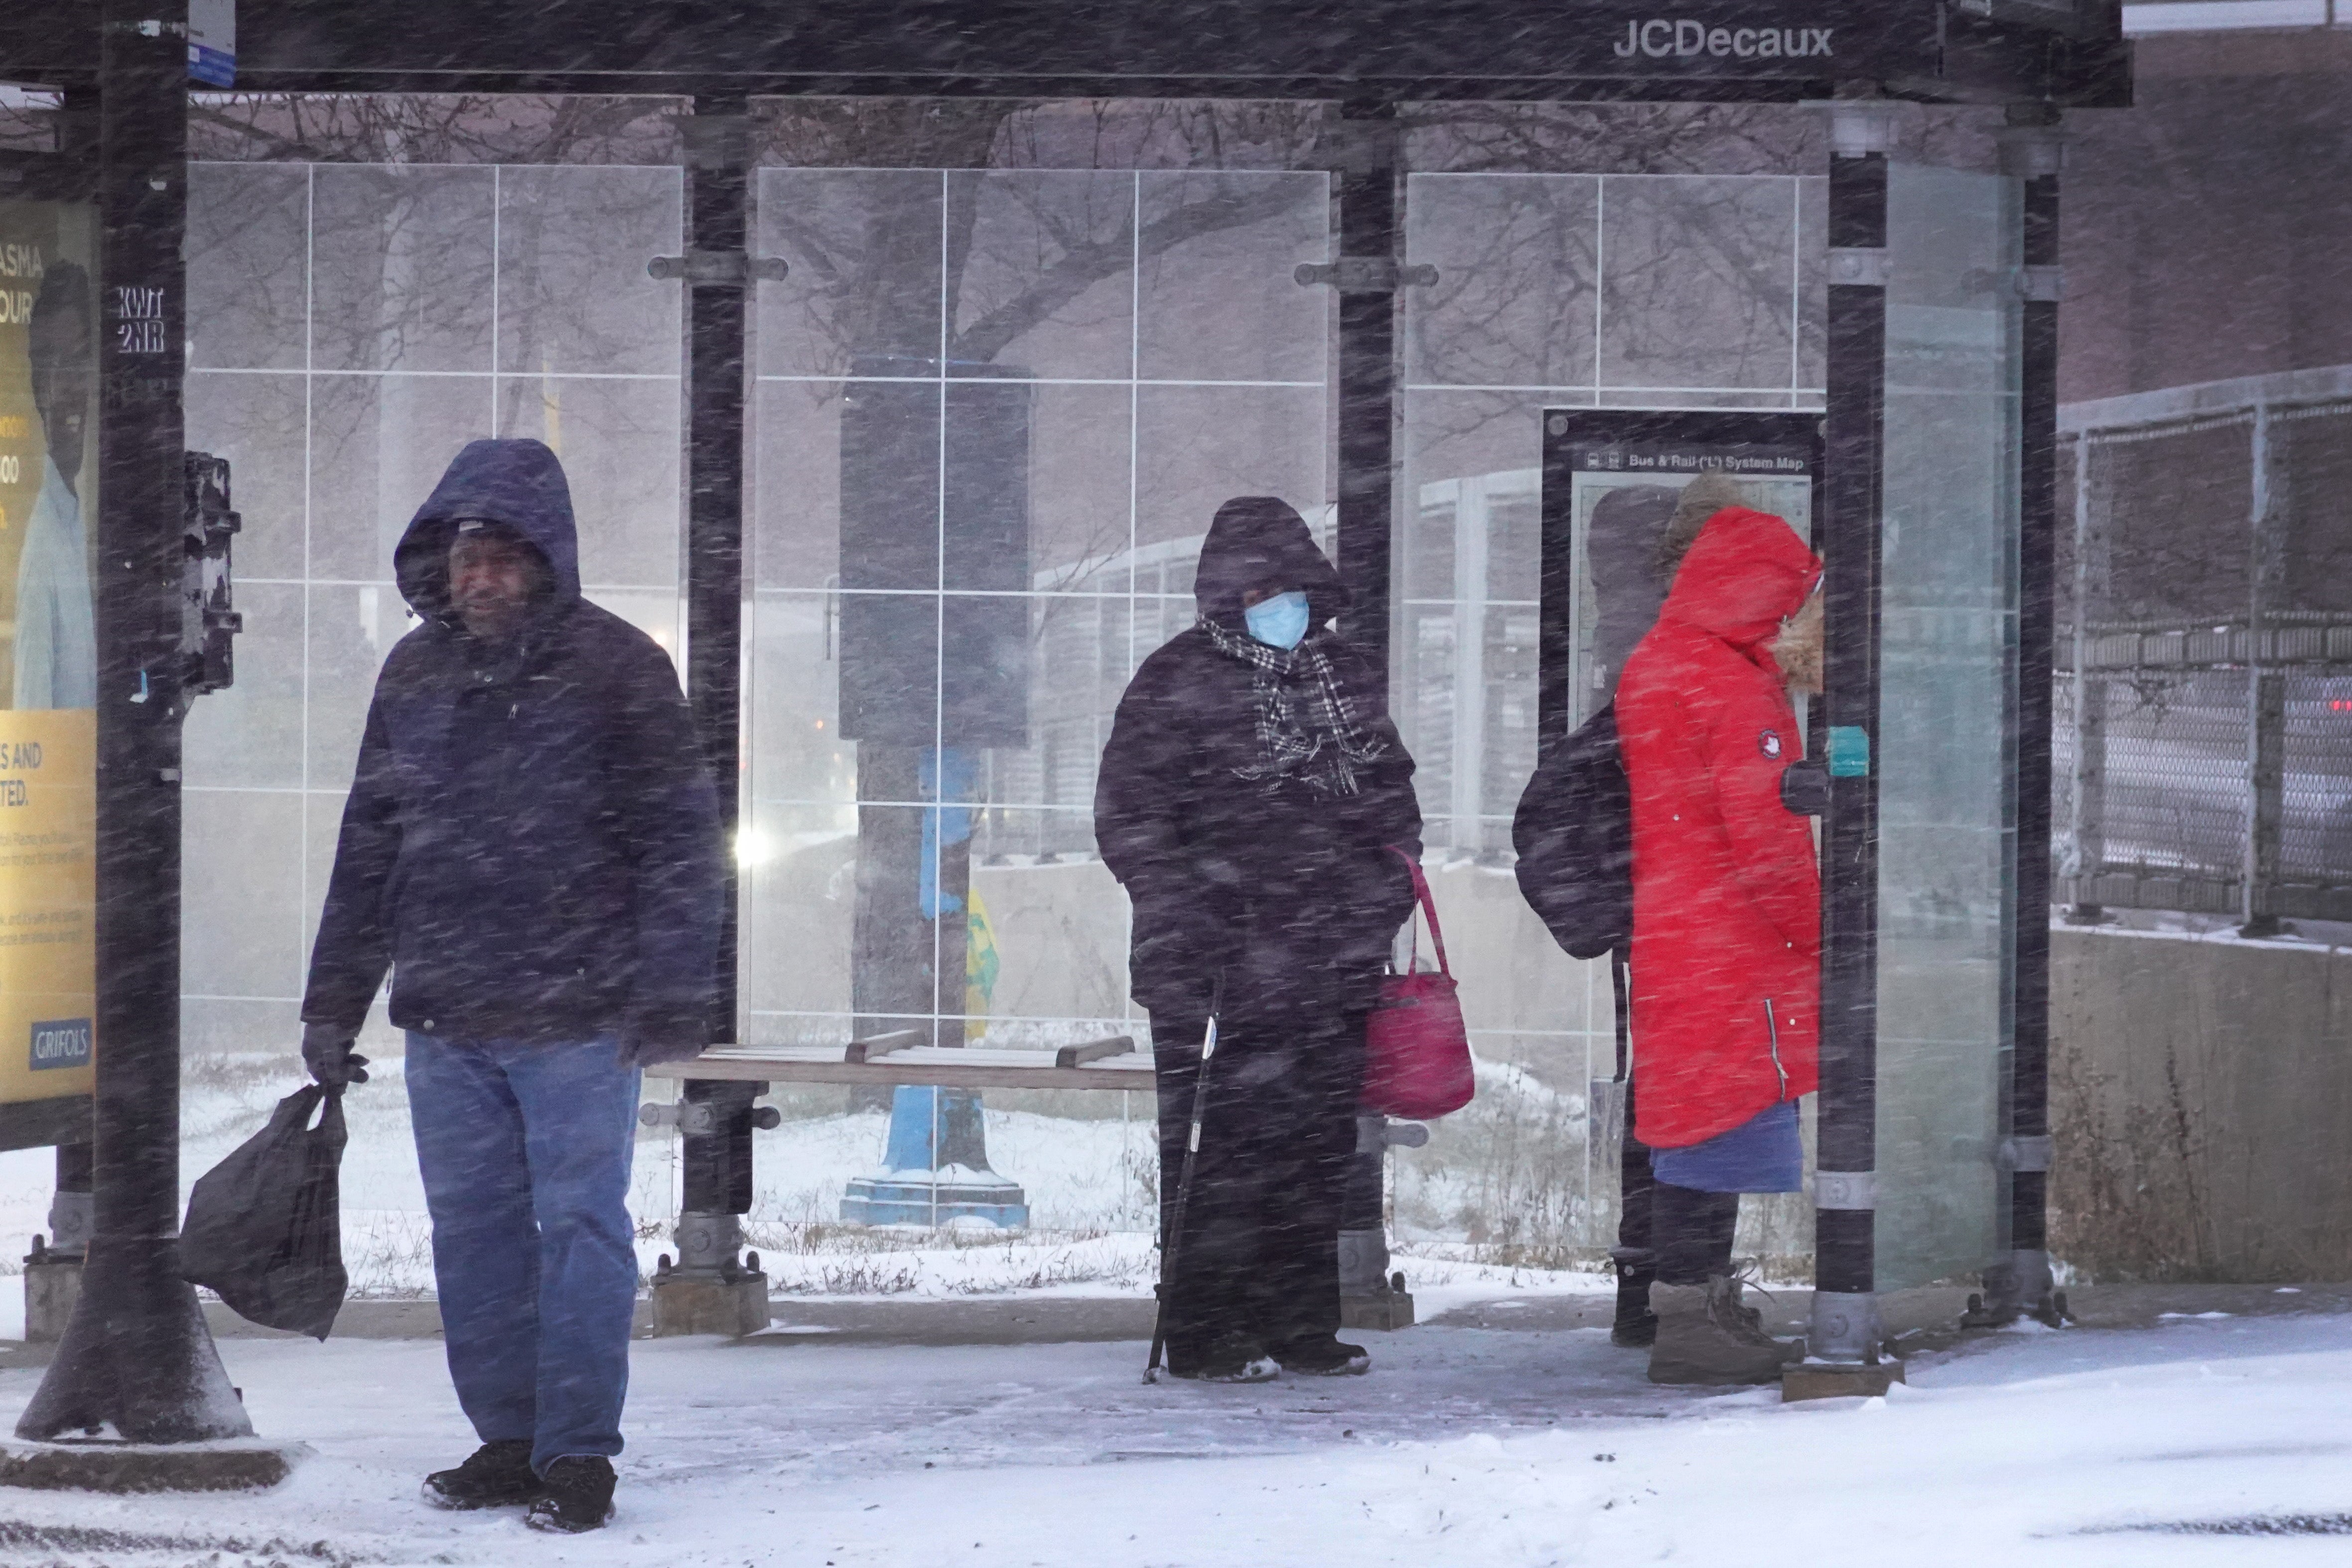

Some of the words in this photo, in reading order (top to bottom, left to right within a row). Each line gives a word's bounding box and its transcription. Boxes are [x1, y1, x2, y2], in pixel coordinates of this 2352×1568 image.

[1613, 19, 1834, 57] JCDecaux
[0, 244, 44, 278] ASMA
[0, 290, 32, 324] OUR
[1629, 454, 1654, 466] Bus
[1658, 454, 1667, 467] &
[1671, 454, 1696, 467] Rail
[1725, 455, 1773, 470] System
[1777, 457, 1804, 472] Map
[12, 742, 42, 769] AND
[35, 1028, 87, 1059] GRIFOLS
